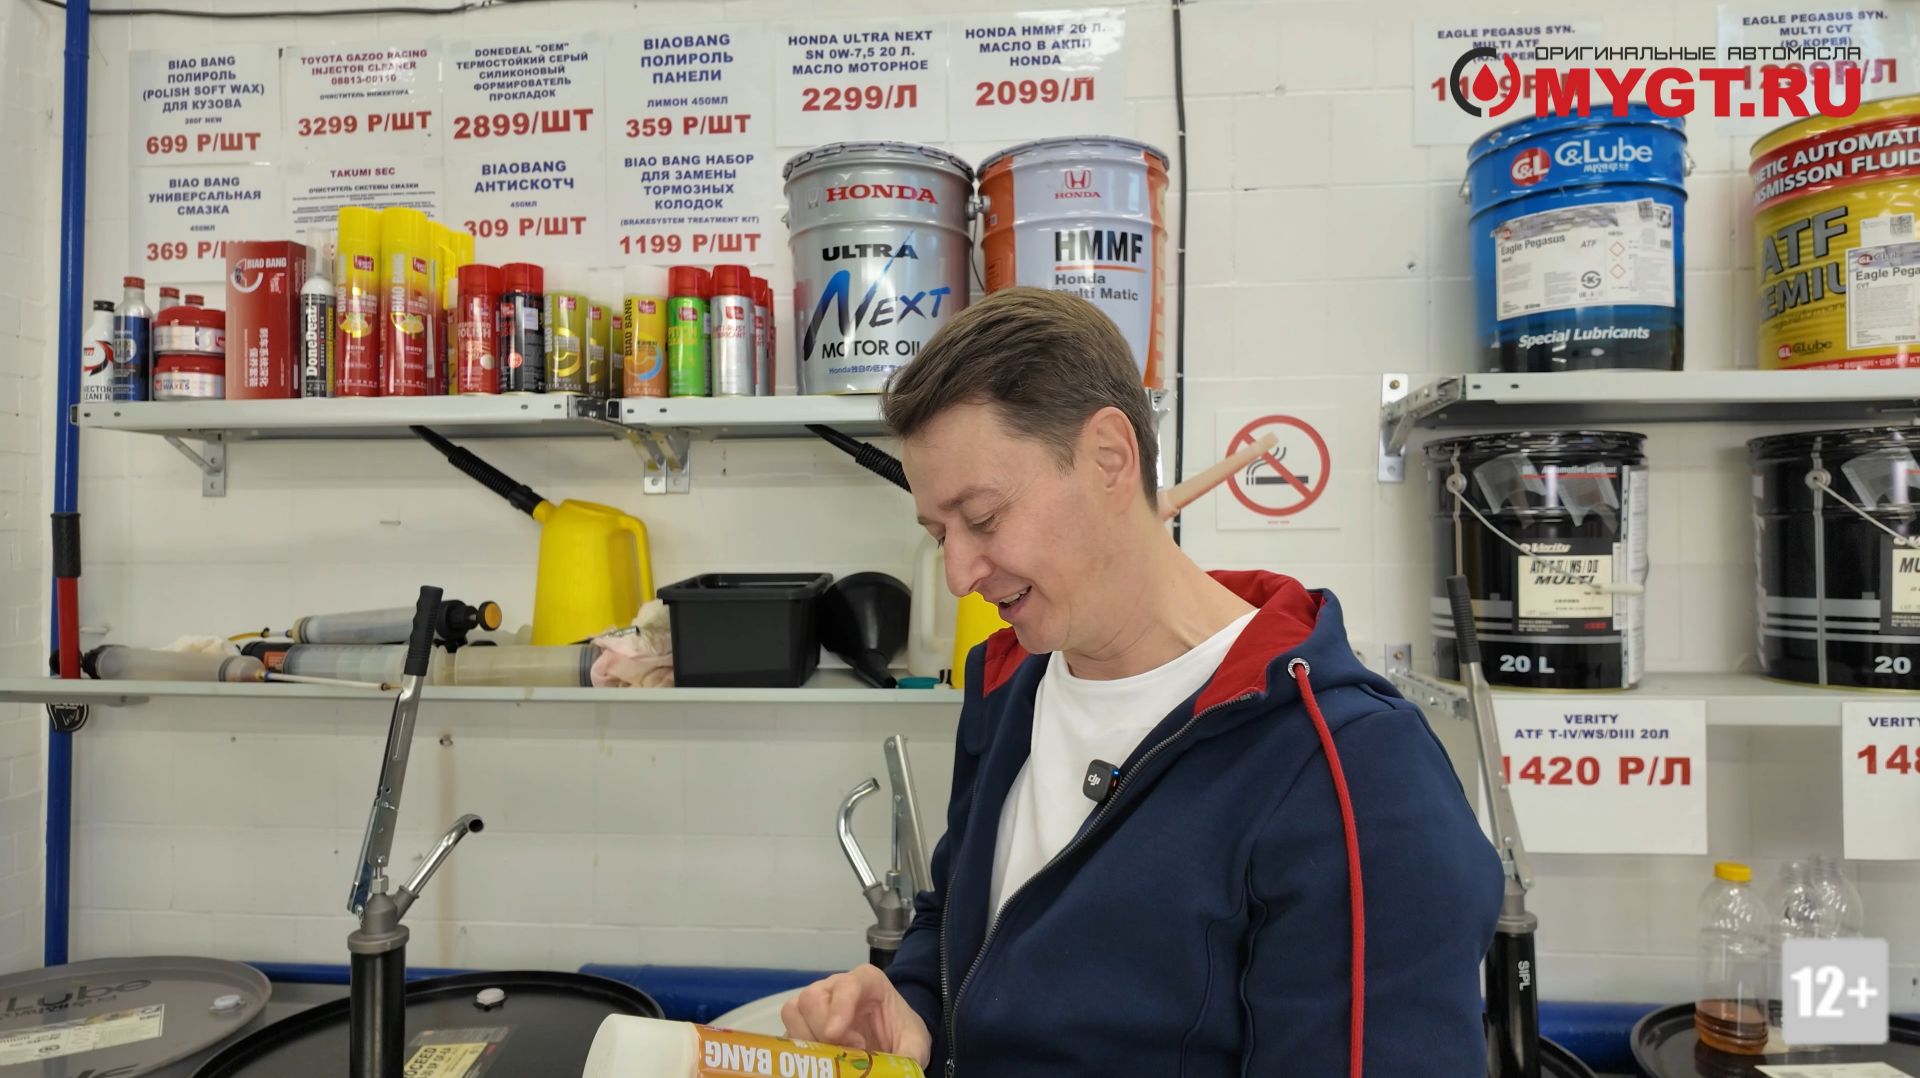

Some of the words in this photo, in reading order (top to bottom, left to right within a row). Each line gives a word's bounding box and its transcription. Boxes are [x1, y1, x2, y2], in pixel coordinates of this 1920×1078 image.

[1743, 15, 1786, 26] EAGLE
[1791, 12, 1853, 23] PEGASUS
[1858, 11, 1888, 20] SYN.
[788, 34, 838, 46] HONDA
[843, 32, 890, 43] ULTRA
[895, 30, 932, 42] NEXT
[965, 26, 1017, 39] HONDA
[1022, 24, 1065, 36] HMMF
[1071, 23, 1087, 34] 20
[1437, 28, 1478, 39] EAGLE
[1482, 25, 1541, 37] PEGASUS
[1546, 24, 1575, 35] SYN.
[1780, 27, 1821, 36] MULTI
[1827, 25, 1852, 34] CVT
[644, 34, 730, 50] BIAOBANG
[980, 40, 1031, 52] МАСЛО
[1037, 39, 1046, 50] В
[1051, 38, 1091, 49] АКПП
[1473, 41, 1511, 49] MULTI
[1516, 40, 1539, 48] ATF
[301, 54, 343, 65] TOYOTA
[346, 52, 384, 62] GAZOO
[387, 49, 428, 60] RACING
[475, 45, 532, 57] DONEDEAL
[806, 49, 824, 59] SN
[829, 46, 874, 59] 0W-7,5
[880, 46, 896, 58] 20
[901, 45, 915, 57] Л.
[168, 58, 198, 70] BIAO
[201, 56, 235, 67] BANG
[457, 54, 545, 70] ТЕРМОСТОЙКИЙ
[549, 51, 588, 63] СЕРЫЙ
[641, 52, 734, 68] ПОЛИРОЛЬ
[792, 62, 843, 75] МАСЛО
[848, 60, 928, 73] МОТОРНОЕ
[1010, 54, 1061, 67] HONDA
[168, 71, 236, 84] ПОЛИРОЛЬ
[312, 65, 364, 75] INJECTOR
[479, 65, 565, 80] СИЛИКОНОВЫЙ
[653, 70, 721, 85] ПАНЕЛИ
[474, 77, 571, 91] ФОРМИРОВАТЕЛЬ
[976, 76, 1094, 106] 2099/Л
[143, 88, 190, 101] (POLISH
[194, 86, 225, 96] SOFT
[230, 83, 264, 96] WAX)
[490, 89, 556, 102] ПРОКЛАДОК
[802, 84, 917, 111] 2299/Л
[163, 101, 187, 113] ДЛЯ
[192, 99, 242, 110] КУЗОВА
[647, 98, 688, 108] ЛИМОН
[692, 96, 728, 106] 450МЛ
[298, 117, 357, 136] 3299
[368, 111, 432, 133] Р/ШТ
[454, 108, 594, 139] 2899/ШТ
[626, 117, 672, 138] 359
[683, 114, 751, 135] Р/ШТ
[146, 135, 188, 154] 699
[197, 132, 261, 153] Р/ШТ
[482, 160, 566, 176] BIAOBANG
[624, 157, 657, 168] BIAO
[662, 155, 699, 166] BANG
[706, 154, 754, 165] НАБОР
[331, 168, 372, 179] TAKUMI
[375, 167, 395, 176] SEC
[641, 171, 670, 183] ДЛЯ
[675, 169, 736, 180] ЗАМЕНЫ
[169, 178, 199, 188] BIAO
[204, 177, 240, 187] BANG
[309, 186, 352, 194] ОЧИСТИТЕЛЬ
[475, 178, 574, 193] АНТИСКОТЧ
[644, 184, 734, 196] ТОРМОЗНЫХ
[148, 190, 261, 203] УНИВЕРСАЛЬНАЯ
[826, 184, 938, 204] HONDA
[1055, 191, 1101, 200] HONDA
[177, 205, 229, 216] СМАЗКА
[655, 199, 723, 211] КОЛОДОК
[464, 219, 508, 238] 309
[519, 217, 586, 236] Р/ШТ
[688, 216, 738, 224] TREATMENT
[741, 216, 759, 224] KIT)
[620, 235, 681, 255] 1199
[692, 233, 761, 253] Р/ШТ
[1055, 230, 1143, 263] HMMF
[1762, 206, 1848, 280] ATF
[147, 242, 188, 261] 369
[822, 243, 919, 261] ULTRA
[247, 259, 264, 268] BIAO
[266, 257, 286, 268] BANG
[1055, 273, 1106, 285] Honda
[1856, 270, 1888, 281] Eagle
[1100, 288, 1139, 301] Matic
[1518, 328, 1570, 349] Special
[1574, 326, 1650, 341] Lubricants
[1500, 654, 1532, 673] 20
[1539, 655, 1556, 674] L
[1874, 655, 1912, 674] 20
[1564, 714, 1619, 725] VERITY
[1514, 729, 1543, 739] ATF
[1640, 728, 1670, 740] 20Л
[1502, 756, 1601, 786] 1420
[1619, 755, 1692, 786] Р/Л
[1088, 773, 1101, 785] dji
[705, 1040, 772, 1075] BANG
[780, 1052, 834, 1078] BIAO
